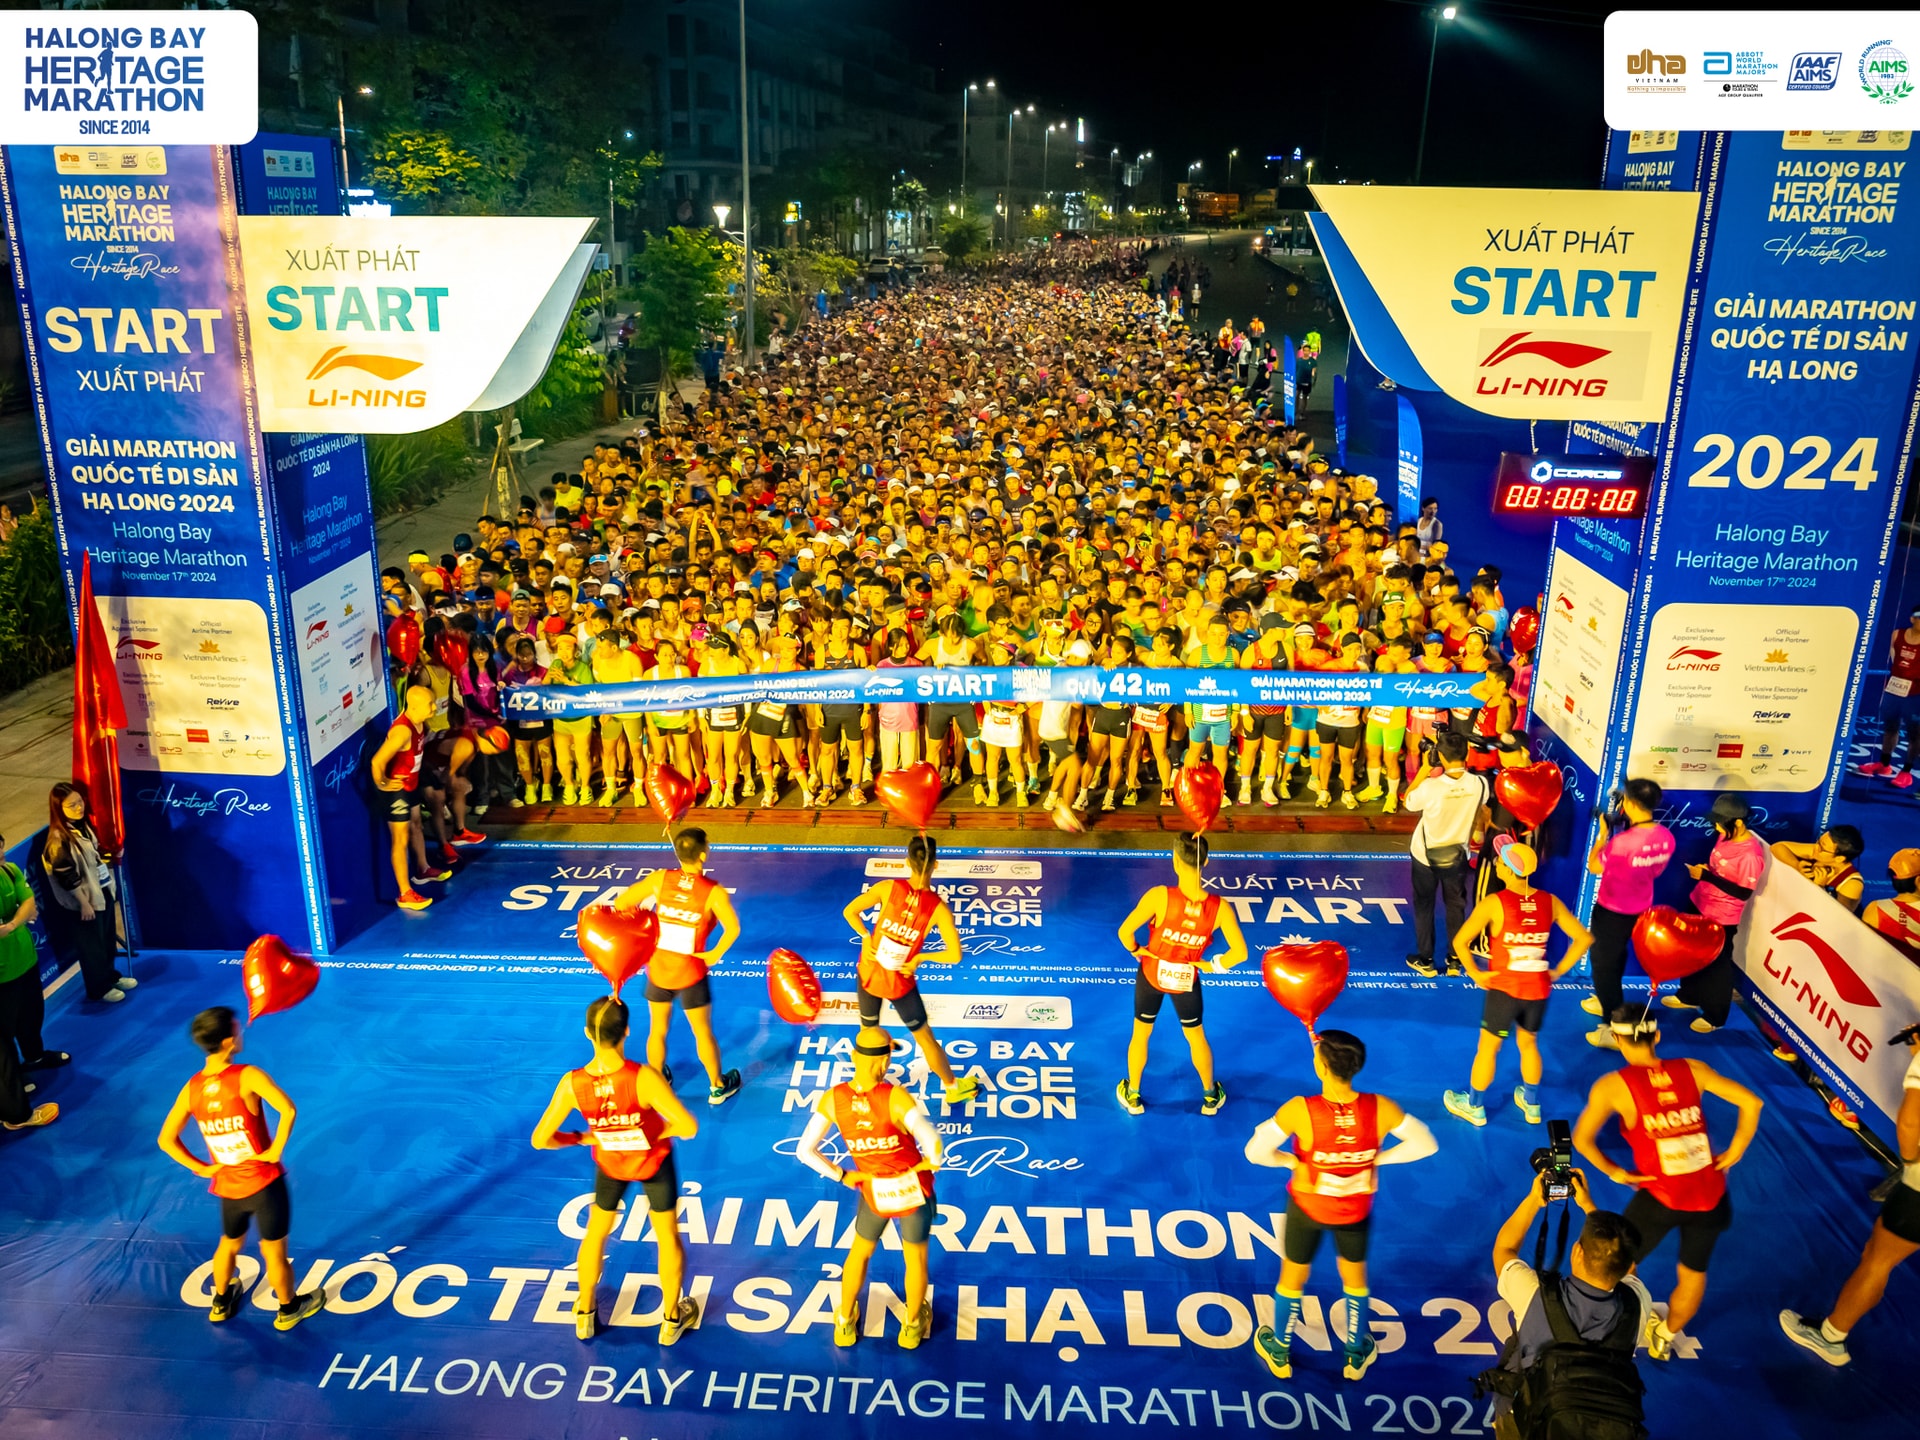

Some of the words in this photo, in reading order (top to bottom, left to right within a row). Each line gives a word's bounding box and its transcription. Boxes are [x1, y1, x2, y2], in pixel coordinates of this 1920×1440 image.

[1710, 132, 1724, 181] MARATHON
[1777, 161, 1860, 178] HALONG
[1863, 162, 1906, 178] BAY
[60, 185, 132, 200] HALONG
[136, 185, 169, 200] BAY
[1704, 181, 1717, 221] HERITAGE
[1768, 205, 1895, 223] MARATHON
[65, 226, 175, 242] MARATHON
[1484, 222, 1557, 252] XUẤT
[1563, 226, 1635, 254] PHÁT
[1701, 222, 1710, 238] BAY
[285, 243, 350, 271] XUẤT
[357, 244, 421, 271] PHÁT
[1695, 239, 1707, 273] HALONG
[1763, 234, 1842, 265] Heritage
[1833, 235, 1888, 264] Race
[70, 251, 140, 281] Heritage
[130, 253, 181, 280] Race
[1450, 266, 1657, 318] START
[1690, 288, 1699, 305] SITE
[266, 285, 449, 332] START
[1714, 292, 1767, 319] GIẢI
[1769, 299, 1916, 320] MARATHON
[45, 306, 222, 354] START
[1684, 306, 1696, 344] HERITAGE
[1710, 323, 1785, 350] QUỐC
[1790, 324, 1822, 350] TẾ
[1823, 331, 1851, 350] DI
[1854, 324, 1908, 351] SẢN
[1678, 345, 1690, 378] UNESCO
[1747, 359, 1783, 384] HẠ
[1789, 361, 1858, 381] LONG
[76, 366, 138, 392] XUẤT
[145, 366, 205, 392] PHÁT
[1476, 377, 1608, 397] LI-NING
[309, 389, 427, 408] LI-NING
[1667, 397, 1681, 449] SURROUNDED
[66, 435, 109, 457] GIẢI
[113, 439, 236, 459] MARATHON
[1662, 450, 1673, 480] COURSE
[1688, 433, 1879, 491] 2024
[72, 462, 135, 485] QUỐC
[138, 463, 165, 485] TẾ
[167, 467, 190, 485] DI
[193, 463, 238, 486] SẢN
[83, 493, 113, 514] HẠ
[116, 494, 175, 511] LONG
[181, 494, 235, 512] 2024
[1505, 485, 1639, 512] 00:00:00
[113, 523, 175, 542] Halong
[180, 523, 212, 543] Bay
[1715, 523, 1787, 546] Halong
[1791, 525, 1830, 547] Bay
[164, 549, 247, 567] Marathon
[1675, 550, 1760, 573] Heritage
[1764, 552, 1859, 571] Marathon
[122, 571, 170, 582] November
[190, 572, 217, 583] 2024
[1709, 575, 1764, 587] November
[1787, 577, 1817, 588] 2024
[1666, 663, 1721, 672] LI-NING
[768, 690, 826, 700] MARATHON
[828, 689, 855, 700] 2024
[799, 679, 819, 688] BAY
[917, 674, 997, 696] START
[1109, 673, 1142, 696] 42
[1146, 681, 1170, 697] km
[1274, 679, 1334, 689] MARATHON
[508, 692, 539, 711] 42
[543, 698, 567, 710] km
[1313, 690, 1343, 701] LONG
[1344, 690, 1371, 701] 2024
[987, 886, 1042, 896] BAY
[1200, 873, 1277, 890] XUẤT
[1286, 875, 1364, 890] PHÁT
[1160, 968, 1192, 980] PACER
[1763, 948, 1873, 1063] LI-NING
[990, 1041, 1075, 1061] BAY
[1846, 1088, 1864, 1109] 2024
[937, 1123, 973, 1135] 2014
[846, 1135, 900, 1152] PACER
[957, 1285, 1105, 1363] HẠ
[318, 1353, 566, 1400] HALONG
[577, 1365, 694, 1406] BAY
[703, 1369, 985, 1421] HERITAGE
[1005, 1384, 1352, 1432] MARATHON
[1364, 1394, 1496, 1436] 202
